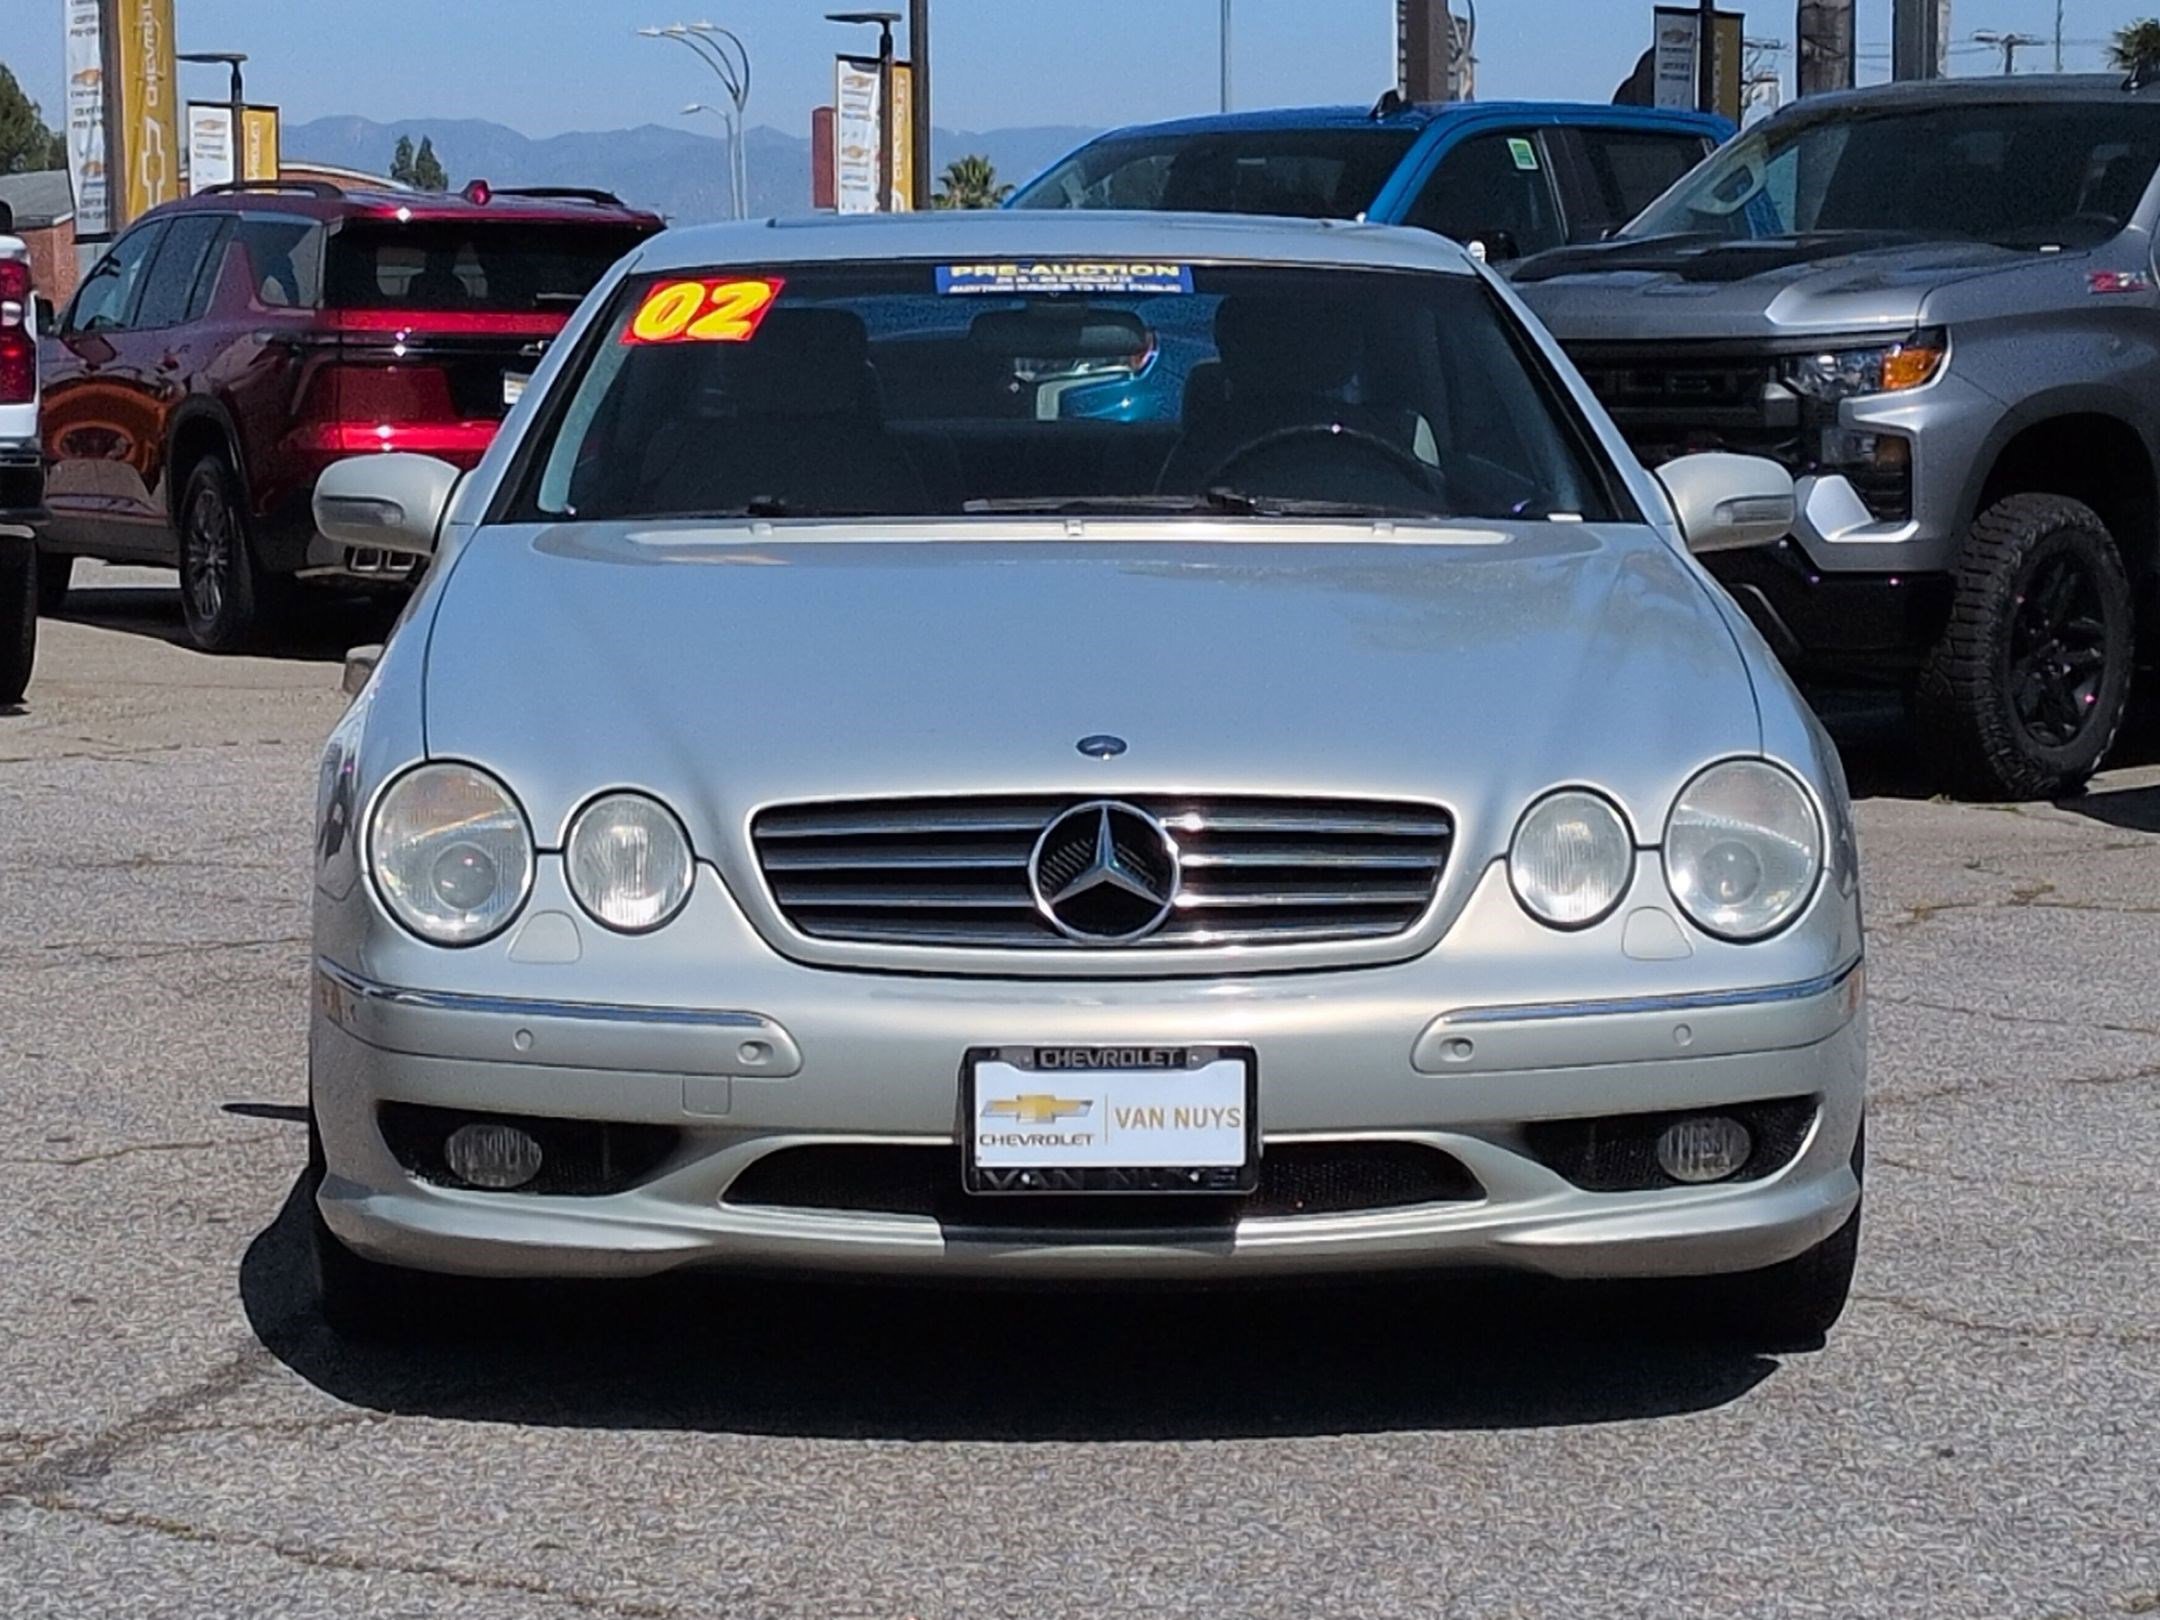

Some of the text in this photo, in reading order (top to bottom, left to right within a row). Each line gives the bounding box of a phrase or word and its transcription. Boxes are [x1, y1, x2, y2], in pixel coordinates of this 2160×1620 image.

[950, 264, 1180, 277] PRE-AUCTION
[633, 281, 772, 341] 02
[1040, 1048, 1178, 1068] CHEVROLET
[1115, 1106, 1241, 1129] VAN NUYS
[979, 1133, 1095, 1147] CHEVROLET
